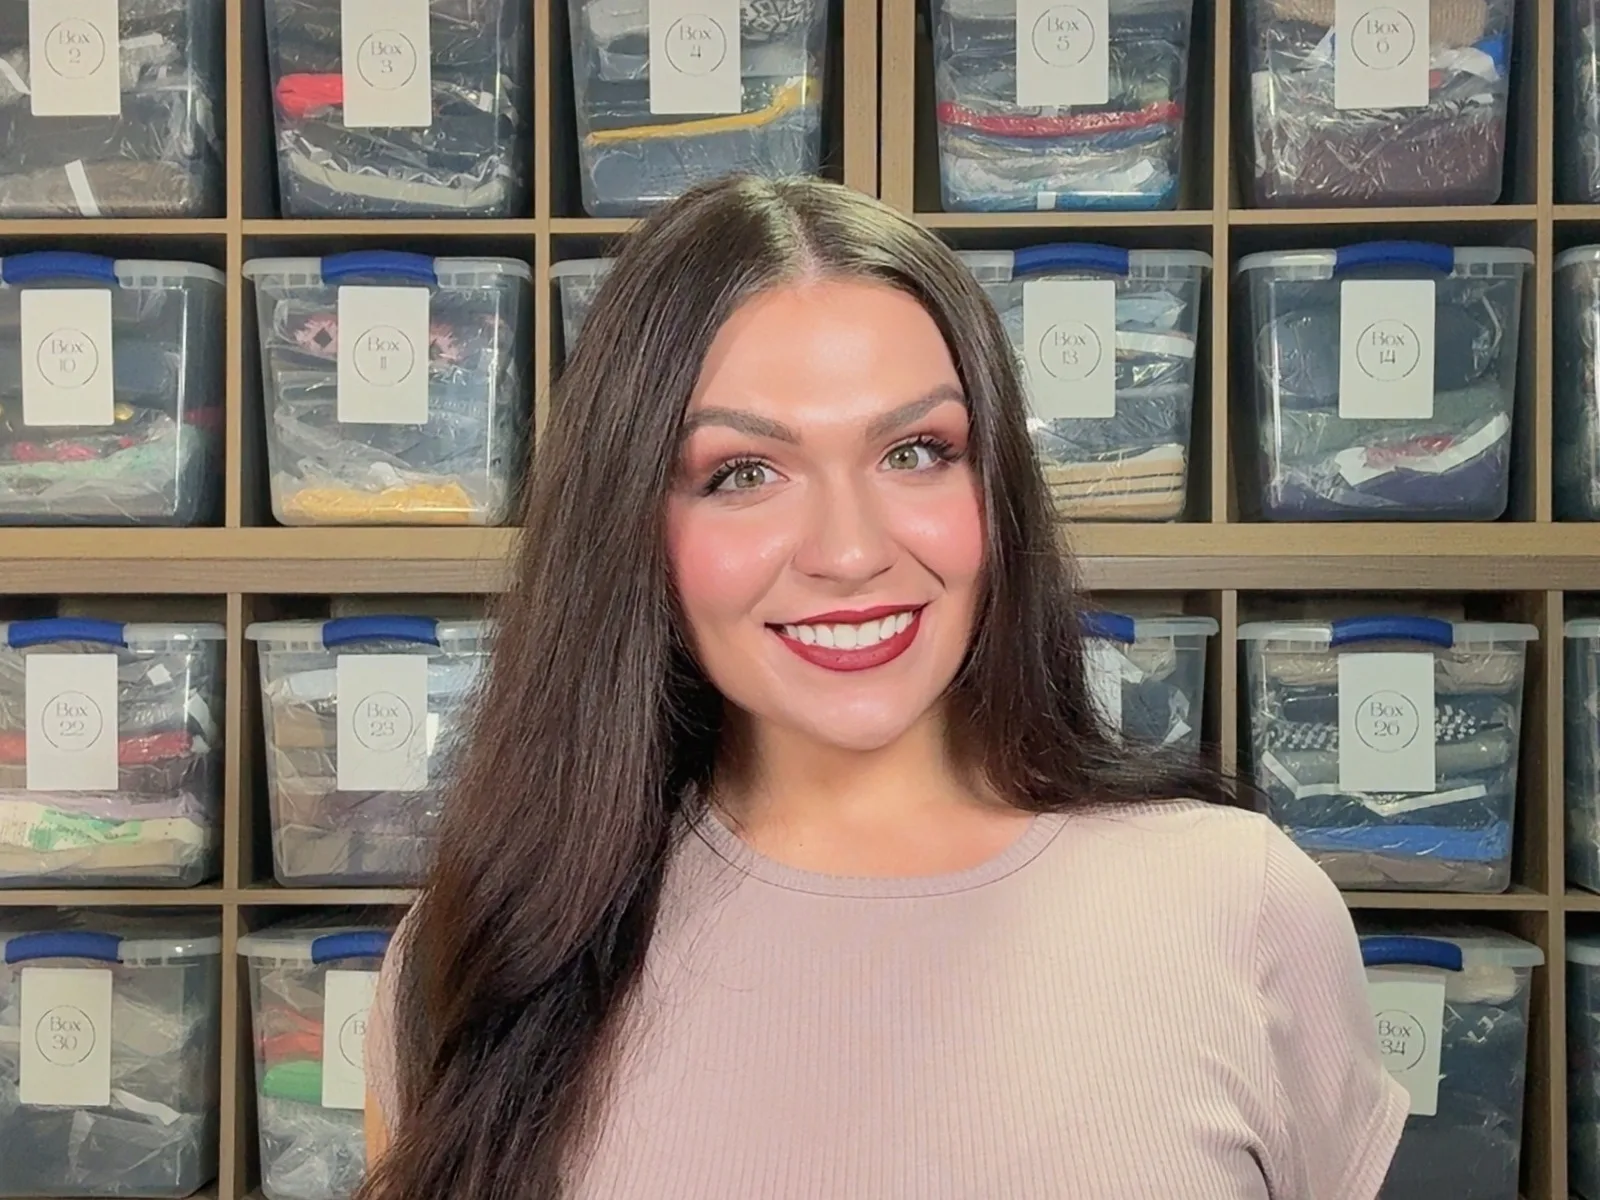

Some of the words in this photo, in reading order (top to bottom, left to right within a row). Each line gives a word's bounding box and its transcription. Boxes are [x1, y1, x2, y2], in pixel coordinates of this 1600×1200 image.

[1047, 17, 1079, 32] Box
[1366, 20, 1399, 35] Box
[58, 30, 90, 44] Box
[680, 26, 712, 41] Box
[371, 42, 402, 56] Box
[1057, 36, 1070, 51] 5
[68, 49, 81, 64] 2
[690, 45, 702, 58] 4
[380, 60, 393, 74] 3
[367, 337, 399, 351] Box
[1054, 332, 1086, 346] Box
[1371, 332, 1404, 346] Box
[51, 340, 83, 354] Box
[1062, 352, 1078, 365] 13
[1380, 350, 1396, 364] 14
[59, 359, 75, 373] 10
[56, 703, 88, 717] Box
[367, 704, 398, 718] Box
[1370, 702, 1403, 717] Box
[60, 721, 84, 736] 22
[371, 722, 394, 737] 23
[50, 1017, 81, 1031] Box
[1379, 1021, 1411, 1037] Box
[52, 1035, 77, 1050] 30
[1381, 1039, 1405, 1055] 34
